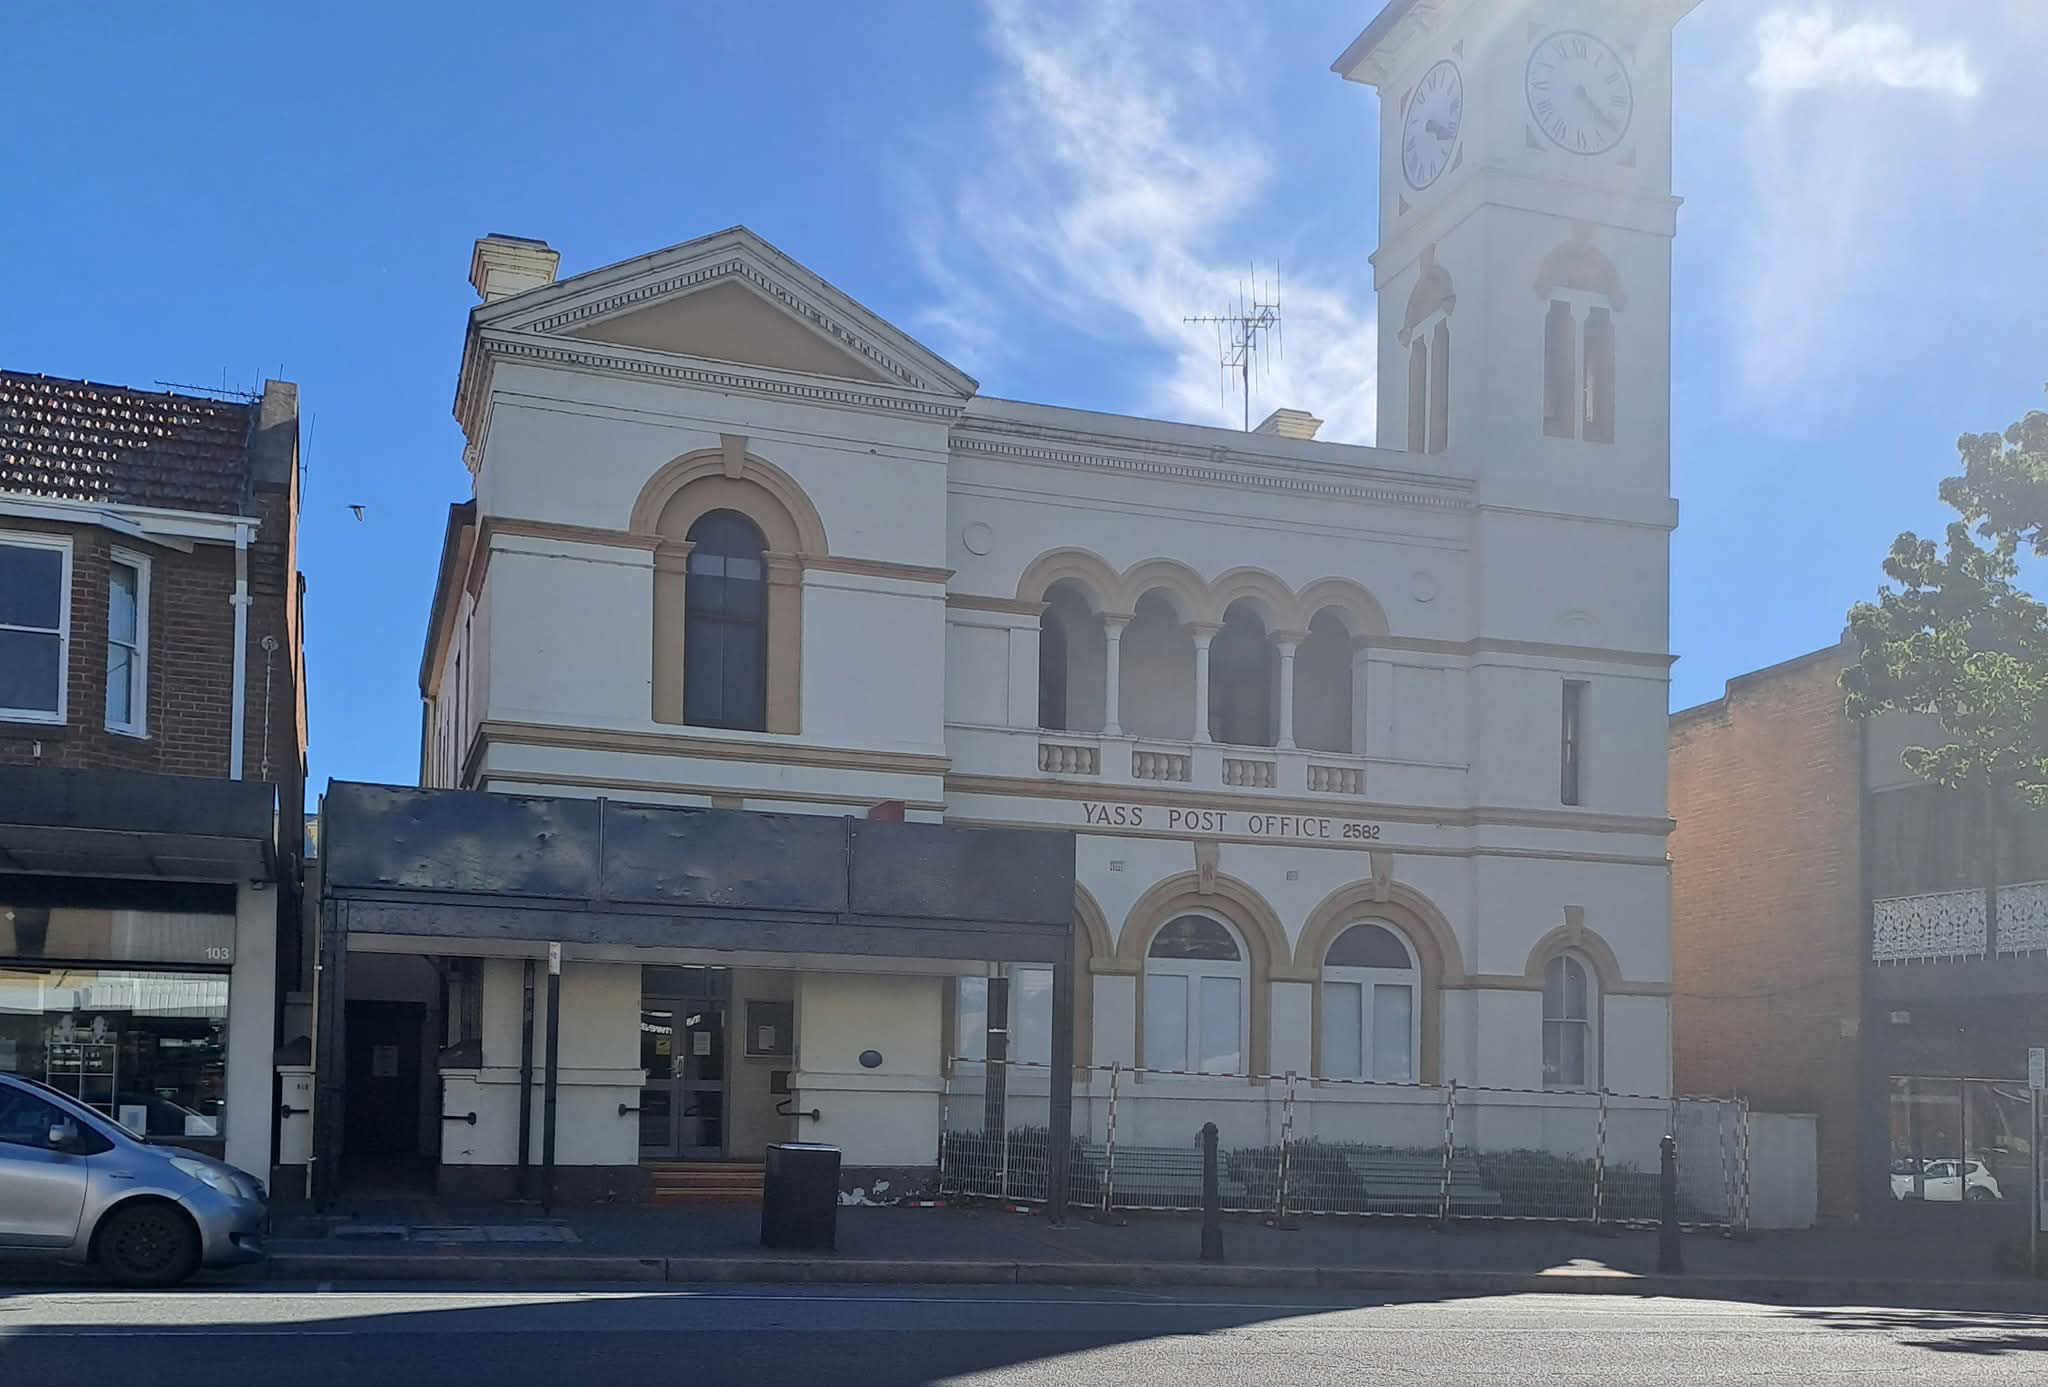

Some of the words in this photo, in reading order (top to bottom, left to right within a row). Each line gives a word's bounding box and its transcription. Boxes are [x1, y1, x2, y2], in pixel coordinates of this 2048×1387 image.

[1082, 802, 1143, 826] YASS
[1168, 809, 1228, 832] POST
[1248, 815, 1331, 838] OFFICE
[1342, 823, 1381, 839] 2582
[205, 947, 230, 960] 103
